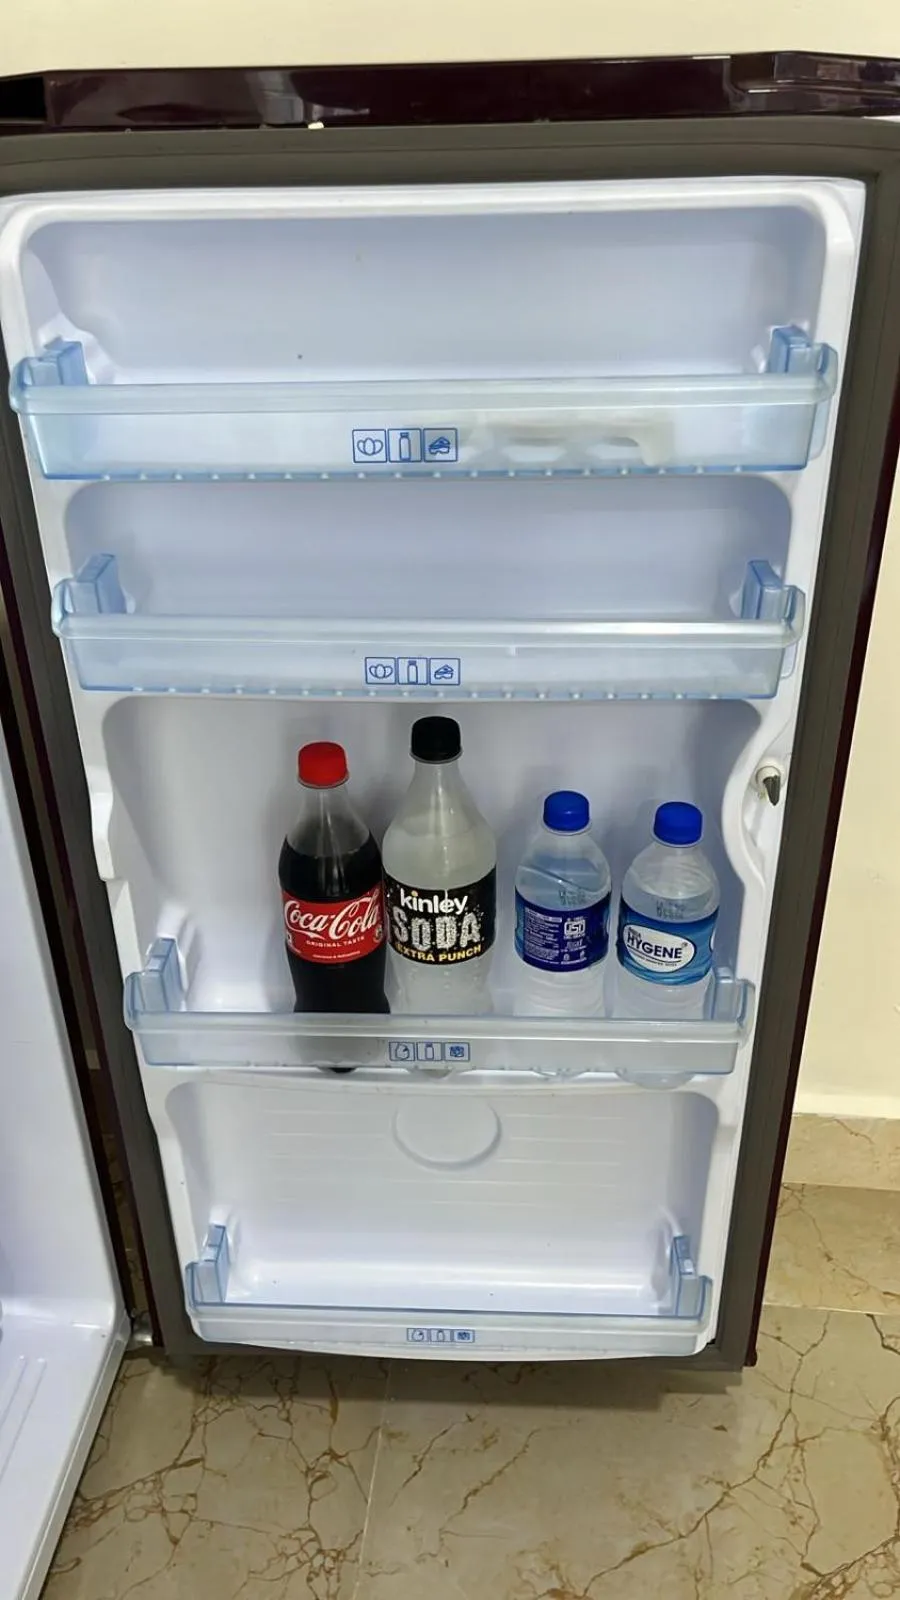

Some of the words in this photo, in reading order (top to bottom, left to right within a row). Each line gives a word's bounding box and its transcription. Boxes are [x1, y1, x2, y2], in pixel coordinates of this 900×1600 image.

[284, 888, 379, 940] Coca-Cola
[400, 888, 468, 915] kinley
[392, 906, 481, 952] SODA
[395, 942, 435, 961] EXTRA
[439, 944, 481, 961] PUNCH
[627, 930, 684, 959] HYGENE
